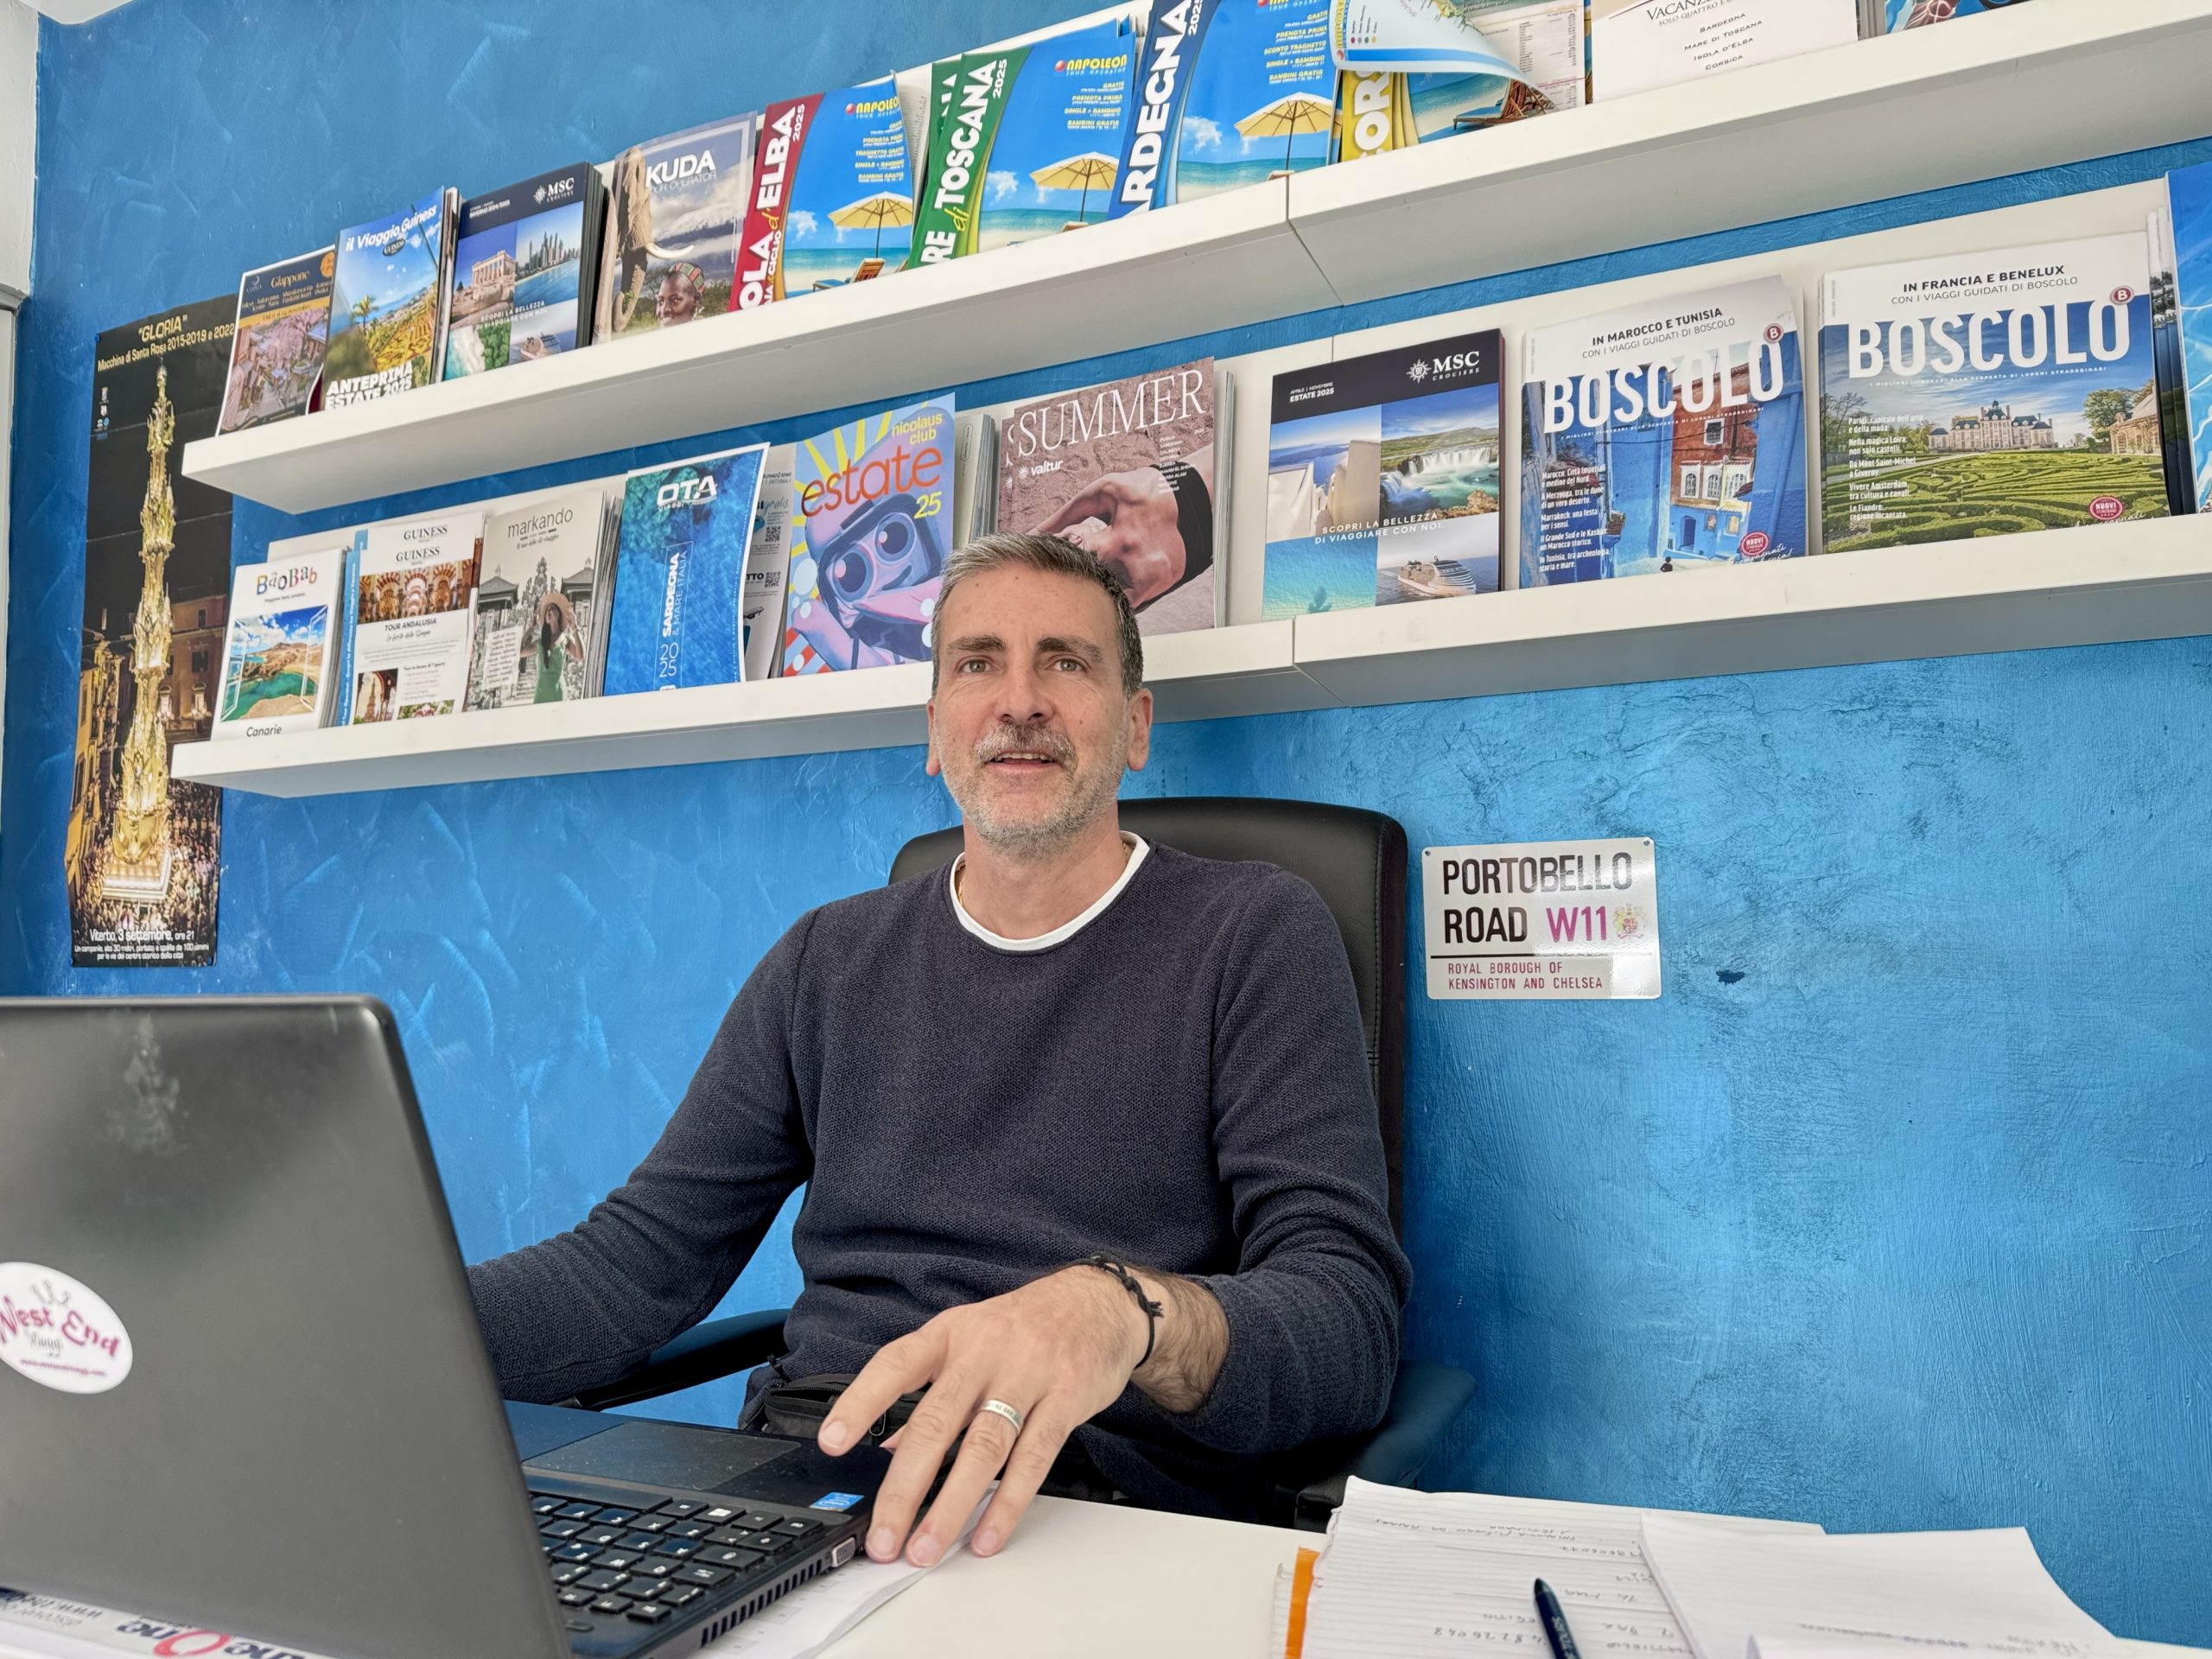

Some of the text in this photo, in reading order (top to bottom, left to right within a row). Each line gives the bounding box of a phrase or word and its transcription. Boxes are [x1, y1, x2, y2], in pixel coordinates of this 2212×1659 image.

[1658, 4, 1718, 26] SOLO QUATTRO
[1700, 13, 1746, 33] SARDEGNA
[1684, 20, 1763, 51] MARE TOSCANA
[1066, 54, 1127, 70] NAPOLEON
[1694, 49, 1719, 61] ISOLA
[1706, 54, 1743, 71] CORSICA
[993, 59, 1007, 99] 2025
[856, 96, 899, 113] NAPOLEO
[792, 104, 804, 143] 2025
[934, 60, 996, 209] TOSCANA
[645, 149, 715, 188] KUDA
[547, 177, 575, 197] MSC
[670, 171, 717, 190] OPERATOR
[739, 106, 795, 309] OLA ELBA
[346, 237, 355, 251] il
[357, 225, 401, 250] Viaggio
[920, 231, 957, 264] RE
[1904, 264, 2064, 292] IN FRANCIA E BENELUX
[1891, 276, 2077, 305] CON VIAGGI GUIDATI DI BOSCOLO
[480, 311, 504, 322] SCOPRI
[515, 301, 545, 314] BELLEZZA
[484, 316, 518, 329] VIAGGIARE
[1592, 308, 1723, 346] IN MAROCCO E TUNISIA
[98, 322, 234, 372] Macchina di Santa Rosa 2015-2019 2022
[1582, 317, 1735, 359] CON VIAGGI GUIDATI DI BOSCOLO
[1849, 299, 2130, 378] BOSCOLO
[1433, 351, 1479, 374] MSC
[326, 359, 413, 396] ANTEPRIMA
[1433, 367, 1479, 381] CROCIERE
[1289, 387, 1334, 403] ESTATE 2025
[1544, 341, 1783, 434] BOSCOLO
[325, 387, 381, 410] ESTATE
[1018, 369, 1206, 456] SUMMER
[1870, 416, 1895, 424] capitale
[892, 412, 943, 437] nicolaus
[910, 429, 937, 445] club
[1848, 437, 1889, 447] Nella magica
[1031, 459, 1064, 476] valtur
[1567, 467, 1580, 476] Città
[1859, 459, 1875, 467] Mont
[1876, 456, 1916, 467] Saint-Michel
[657, 475, 717, 507] OTA
[801, 445, 943, 518] estate
[1546, 477, 1575, 487] medine del
[1584, 486, 1589, 495] le
[1590, 486, 1604, 494] dune
[913, 491, 943, 518] 25
[1555, 499, 1568, 508] vero
[1569, 496, 1591, 505] deserto.
[1860, 491, 1883, 499] cultura
[507, 506, 574, 538] markando
[1584, 508, 1598, 517] festa
[404, 525, 448, 541] GUINESS
[1314, 522, 1445, 544] DI VIAGGIARE CON NOI.
[1322, 512, 1438, 534] SCOPRI LA BELLEZZA
[1545, 532, 1564, 542] Grande
[1566, 531, 1575, 539] Sud
[1548, 538, 1592, 550] Marocco storico.
[1745, 537, 1764, 545] NUOVI
[396, 546, 440, 563] GUINESS
[1560, 561, 1575, 569] mare.
[663, 552, 680, 639] SARDEGNA
[674, 550, 688, 626] MARE ITALIA
[403, 618, 437, 629] ANDALUSIA
[660, 642, 679, 661] 20
[658, 660, 677, 677] 25
[246, 724, 282, 737] Canarie
[1443, 852, 1631, 895] PORTOBELLO
[1444, 906, 1607, 944] ROAD W11
[89, 928, 117, 943] Viterbo,
[118, 929, 124, 941] 3
[126, 929, 173, 943] settembre,
[187, 930, 194, 941] 21
[183, 943, 194, 951] 100
[1448, 961, 1562, 975] ROYAL BOROUGH OF
[1448, 976, 1602, 989] KENSINGTON AND CHELSEA
[62, 1310, 119, 1357] End
